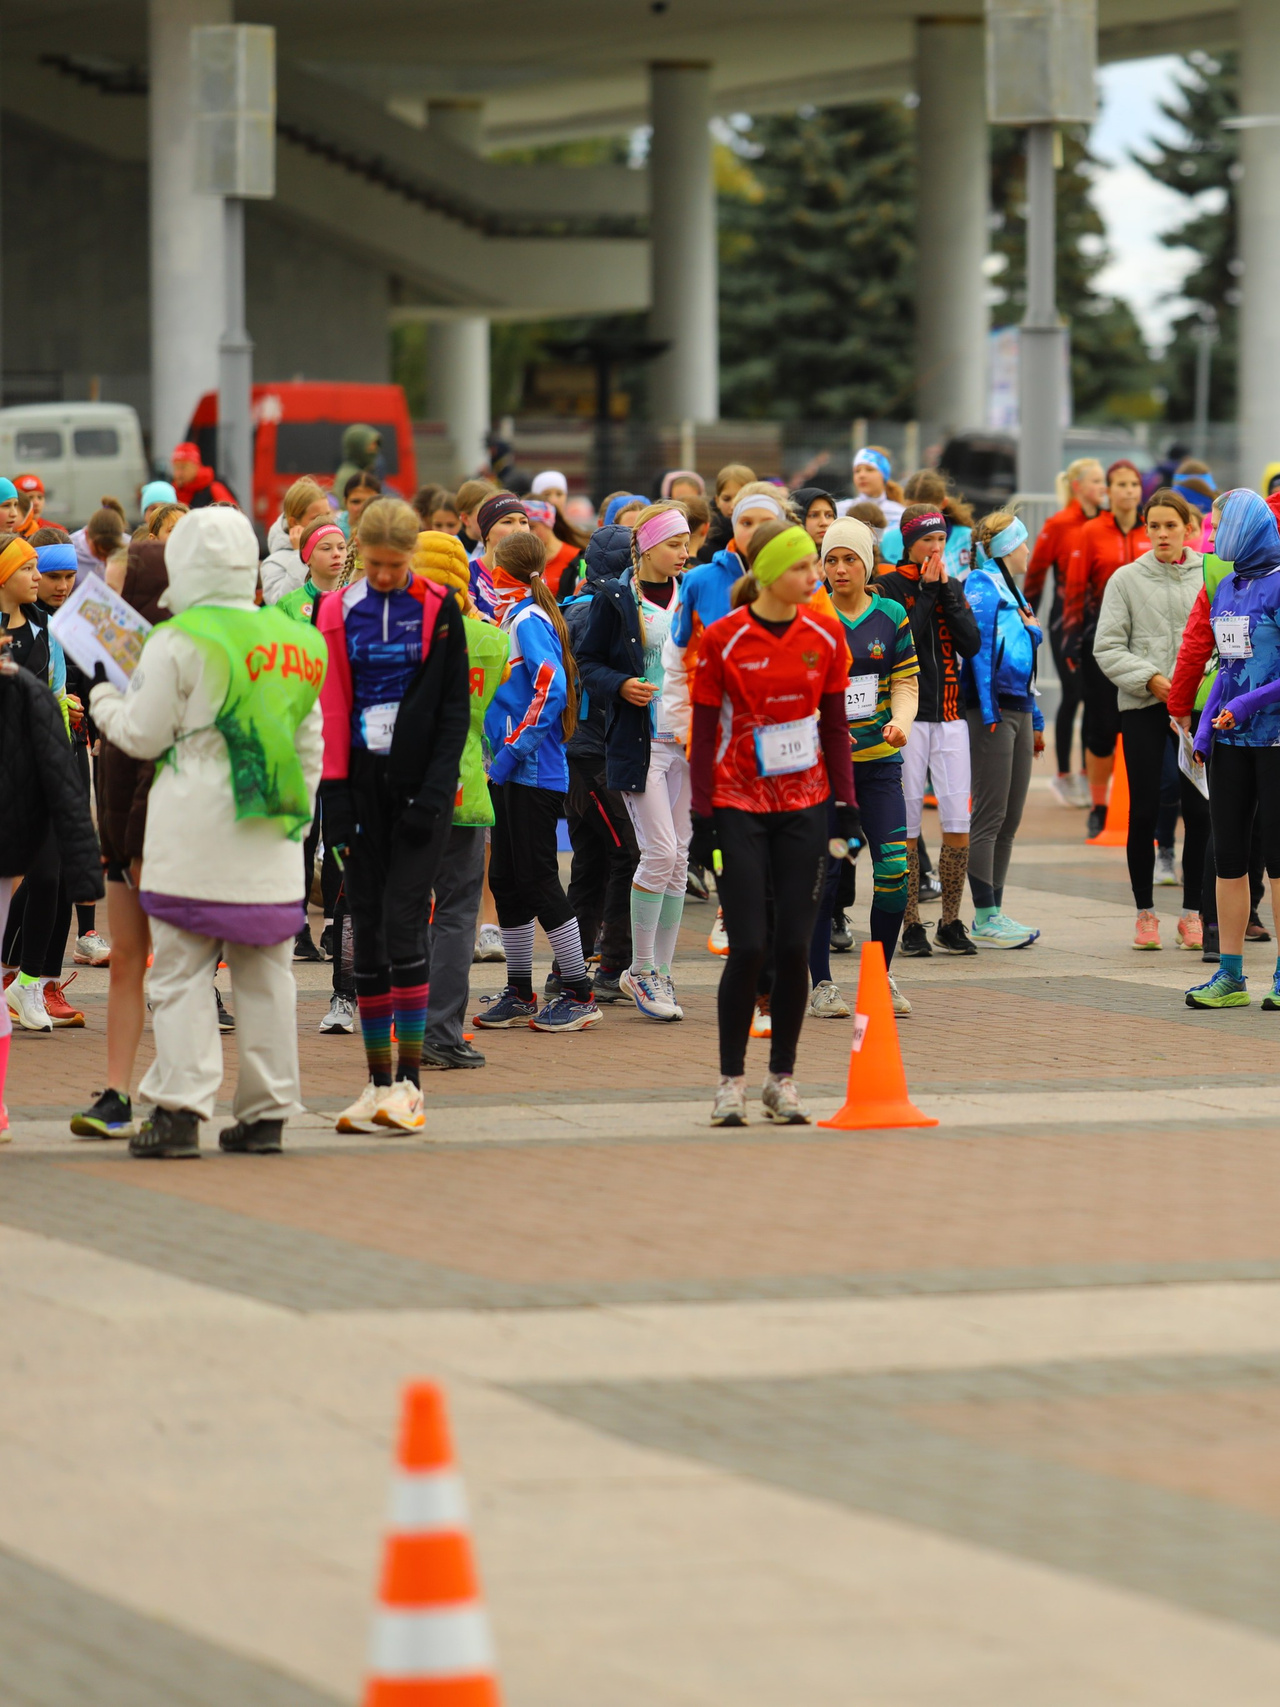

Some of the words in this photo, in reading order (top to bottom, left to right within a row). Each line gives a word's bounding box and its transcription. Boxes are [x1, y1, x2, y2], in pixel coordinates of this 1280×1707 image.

[1222, 633, 1235, 643] 241
[246, 642, 324, 690] СУДЬЯ
[846, 693, 866, 705] 237
[781, 742, 801, 756] 210
